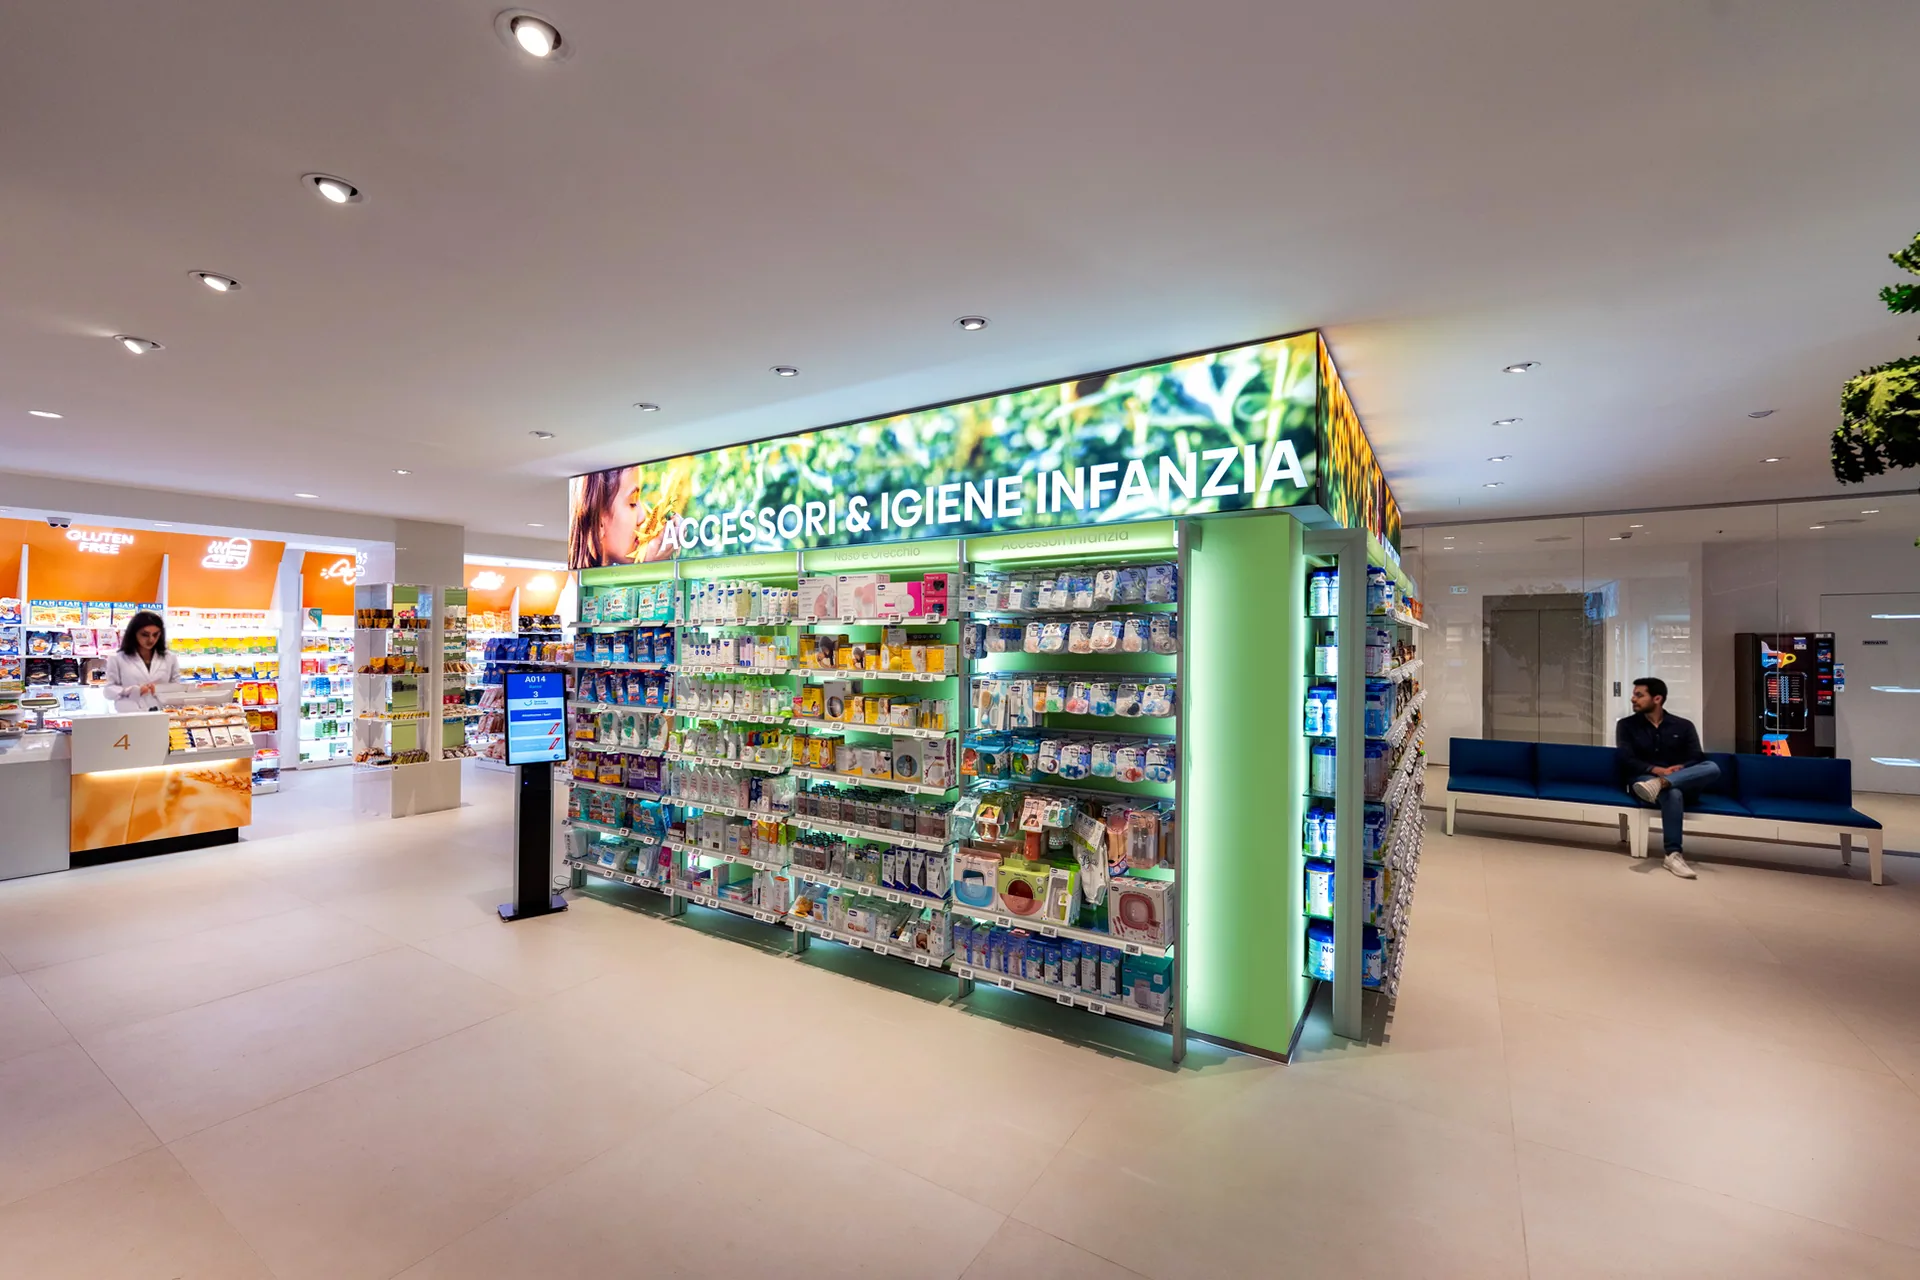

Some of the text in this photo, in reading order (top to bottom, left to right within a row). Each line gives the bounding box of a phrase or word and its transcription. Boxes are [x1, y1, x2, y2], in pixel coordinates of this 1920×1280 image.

[661, 439, 1308, 551] ACCESSORI & IGIENE INFANZIA
[66, 530, 134, 545] GLUTEN
[79, 542, 120, 554] FREE
[834, 547, 921, 561] Naso e Orecchio
[525, 675, 546, 683] A014
[533, 690, 539, 698] 3
[113, 734, 131, 750] 4
